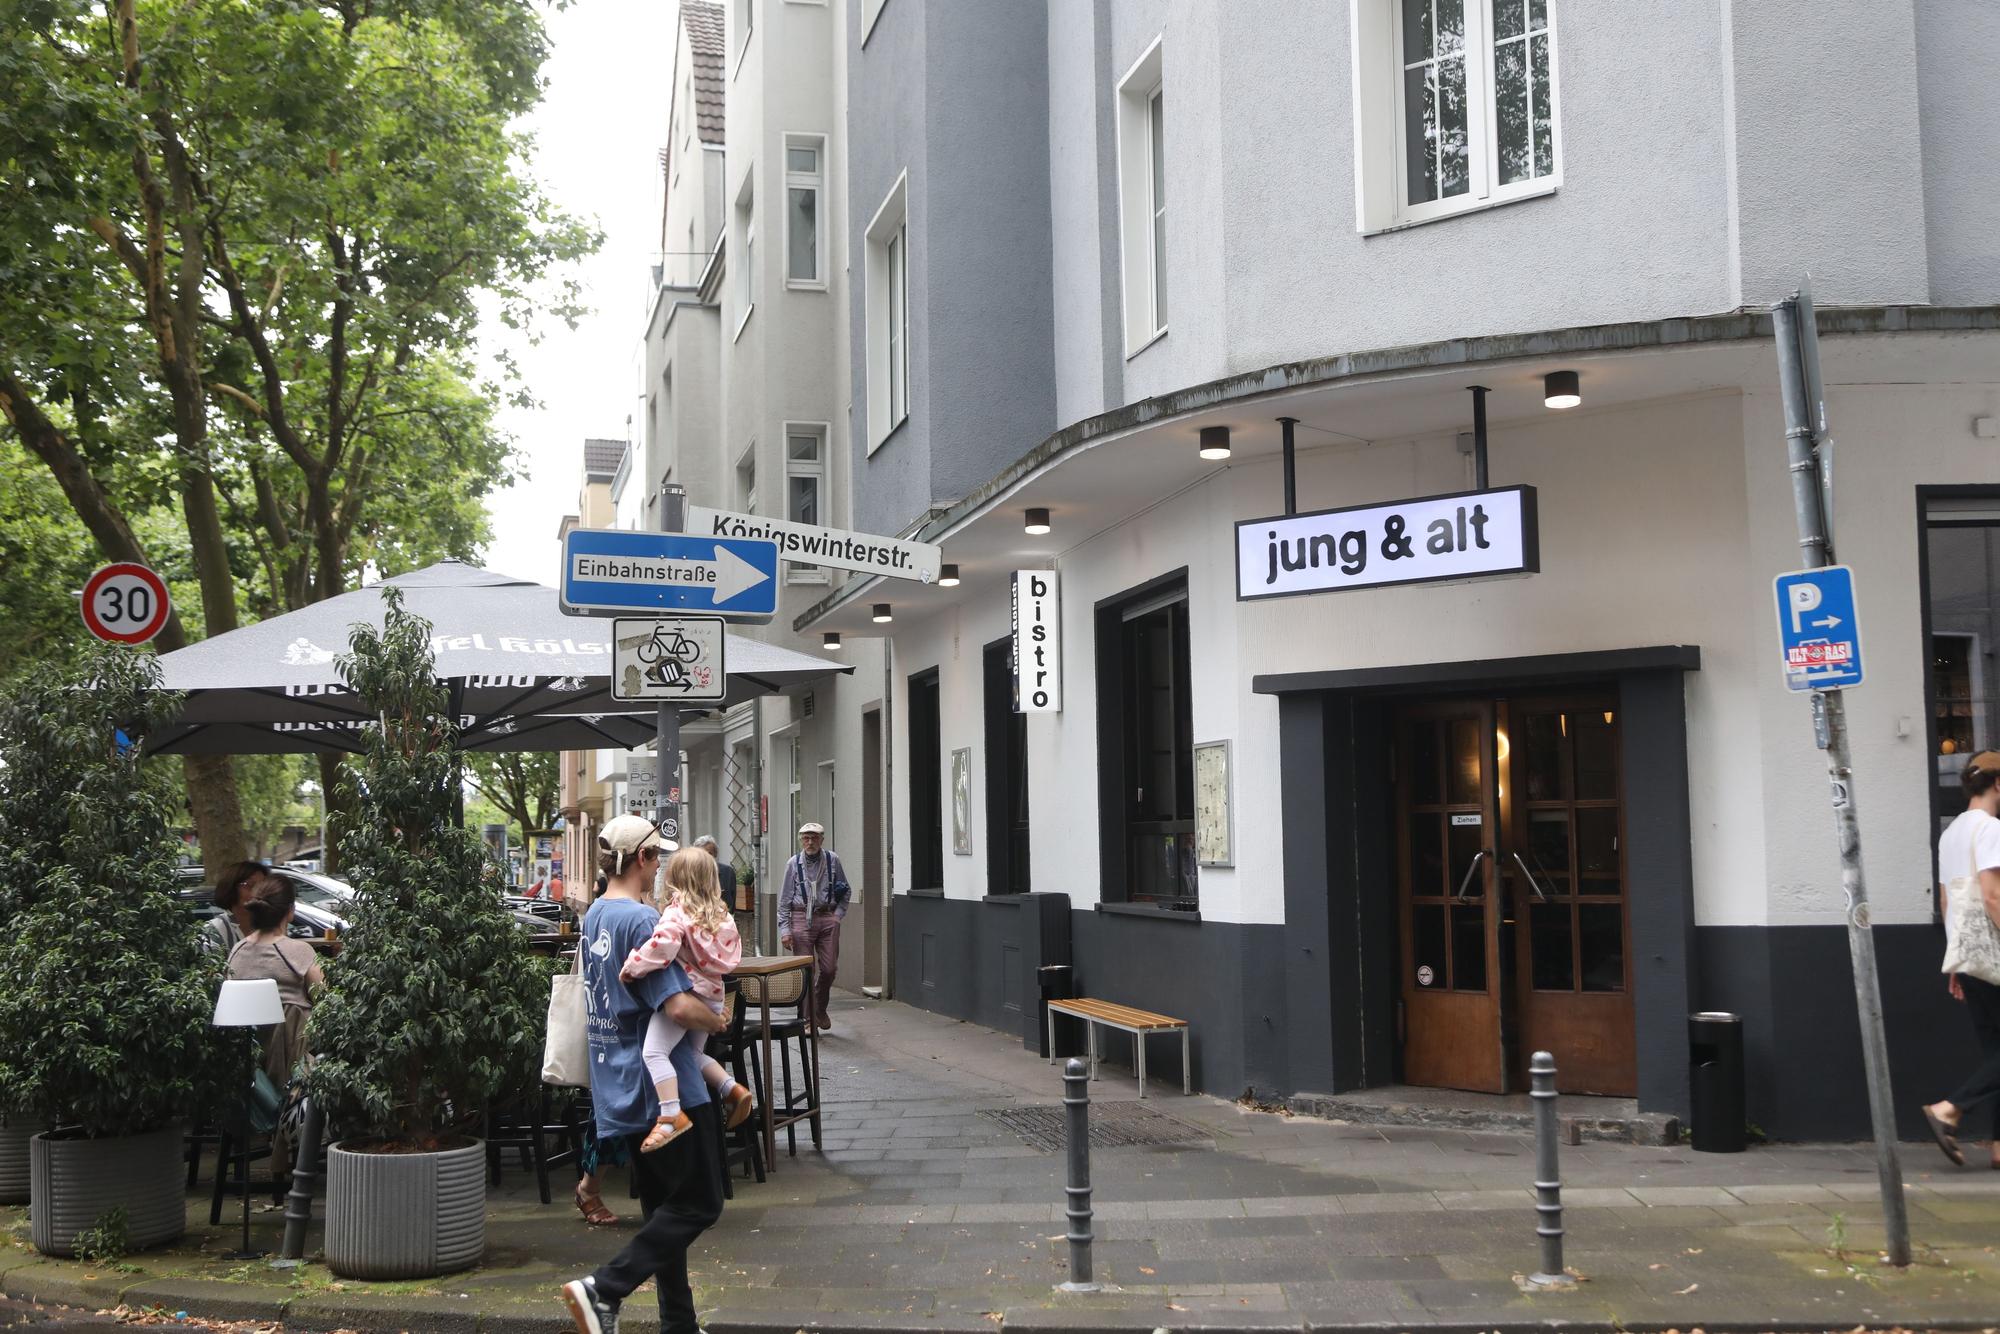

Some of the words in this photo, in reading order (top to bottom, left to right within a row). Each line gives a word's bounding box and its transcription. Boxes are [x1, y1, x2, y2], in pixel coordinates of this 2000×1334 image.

[713, 514, 914, 570] Königswinterstr.
[1266, 530, 1367, 585] jung
[1380, 514, 1415, 561] &
[1426, 504, 1491, 555] alt
[578, 559, 717, 583] Einbahnstraße
[101, 586, 149, 623] 30
[1787, 582, 1823, 633] P
[425, 633, 494, 654] fel
[499, 637, 612, 655] Köls
[1030, 575, 1049, 708] bistro
